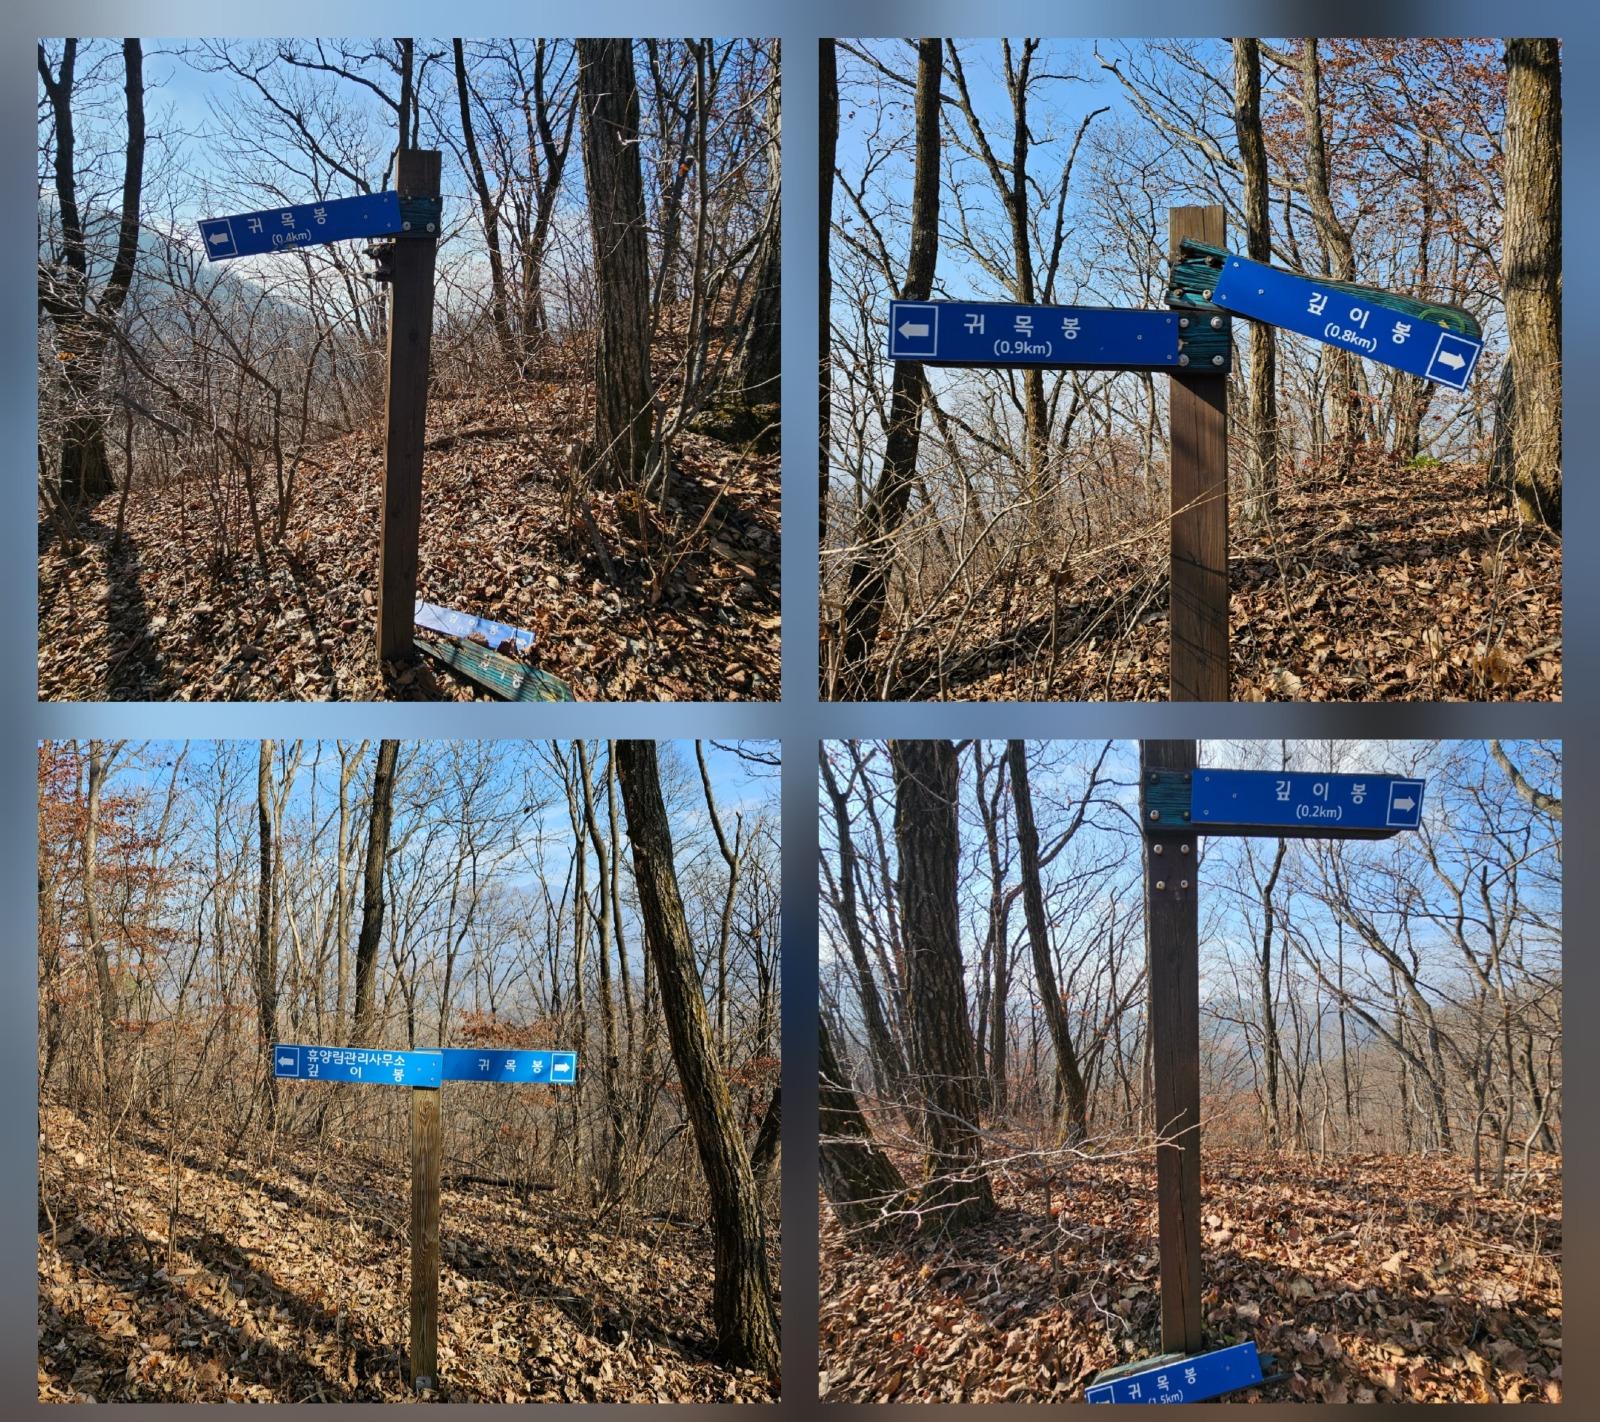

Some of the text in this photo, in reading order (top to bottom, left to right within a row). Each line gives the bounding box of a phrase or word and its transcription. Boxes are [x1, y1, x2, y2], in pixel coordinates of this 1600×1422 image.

[1324, 322, 1378, 353] (0.8km)
[993, 340, 1052, 357] (0.9km)
[1296, 803, 1343, 821] (0.2km)
[307, 1049, 405, 1067] 휴양림관리사무소
